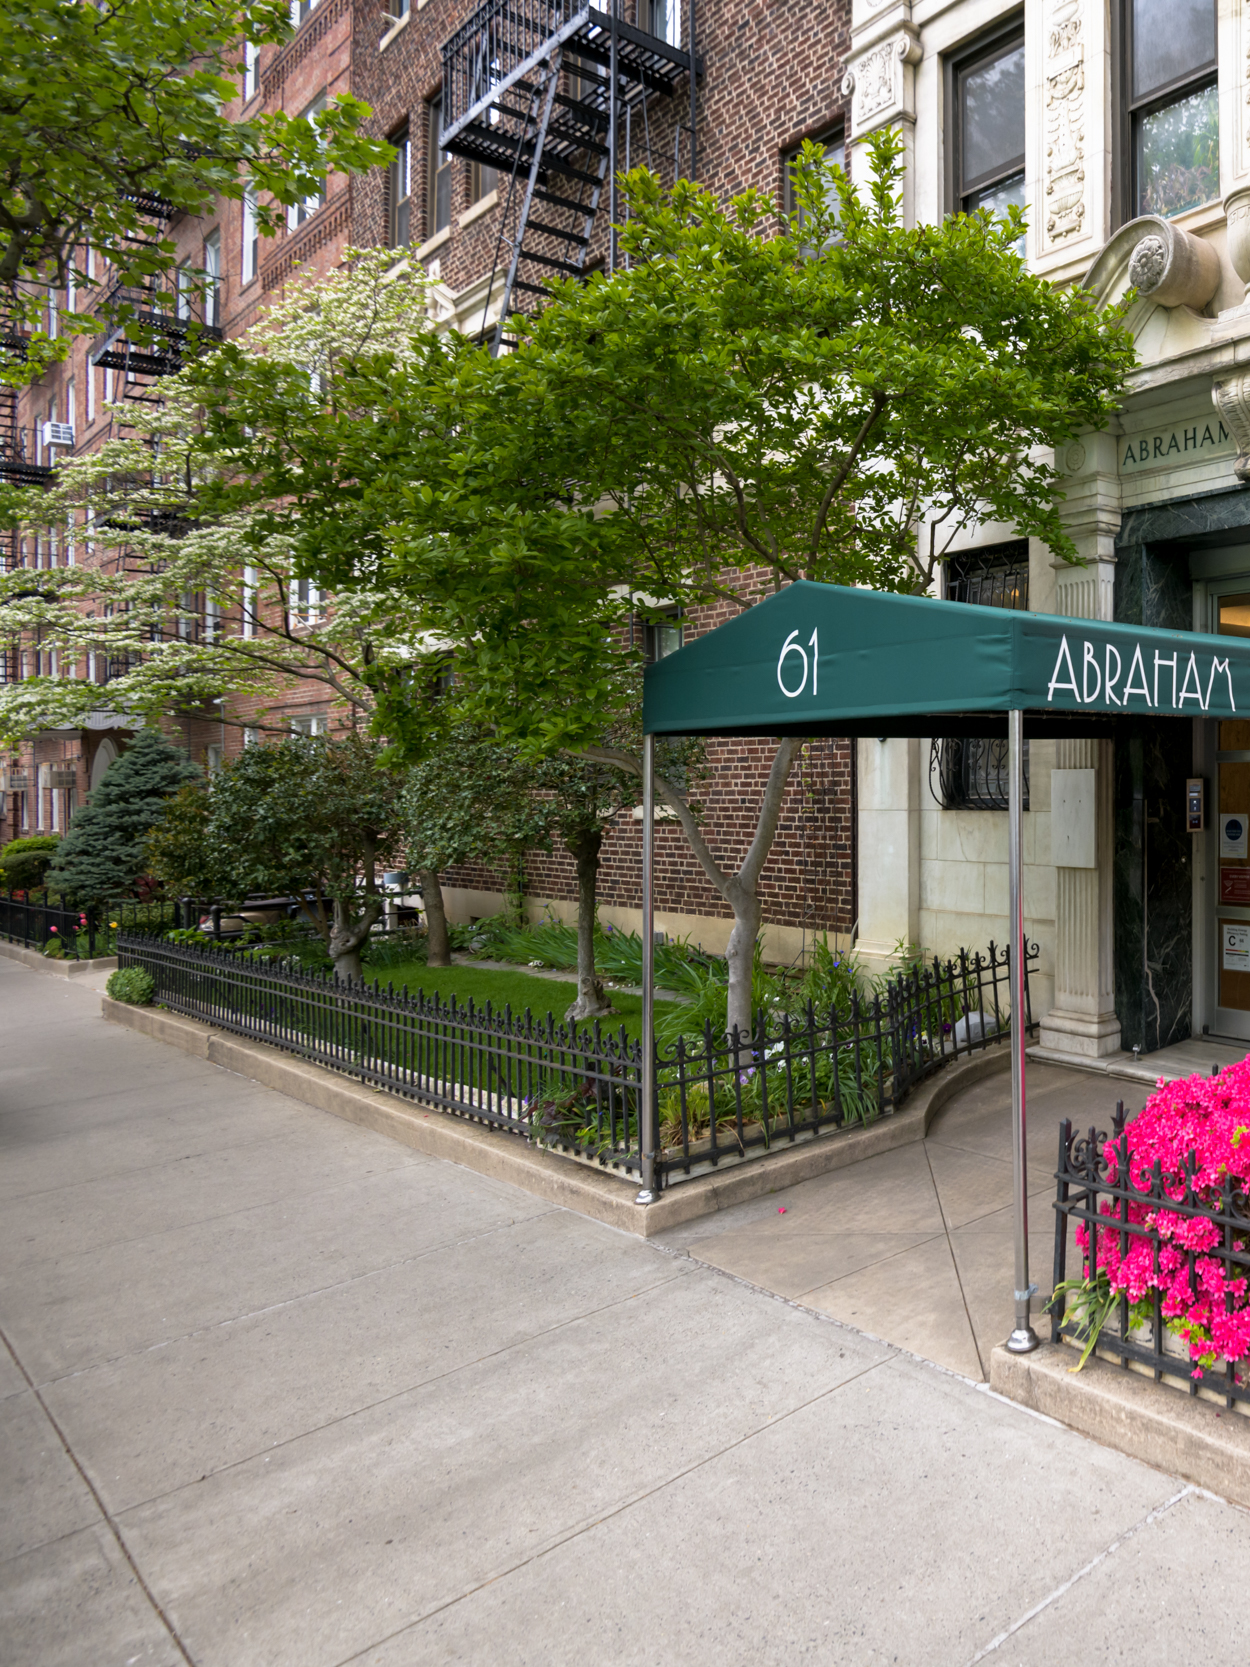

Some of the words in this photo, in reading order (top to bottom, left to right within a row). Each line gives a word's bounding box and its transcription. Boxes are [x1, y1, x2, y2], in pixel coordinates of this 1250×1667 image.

[777, 627, 820, 698] 61
[1047, 634, 1236, 712] ABRAHAM
[1228, 935, 1236, 947] C
